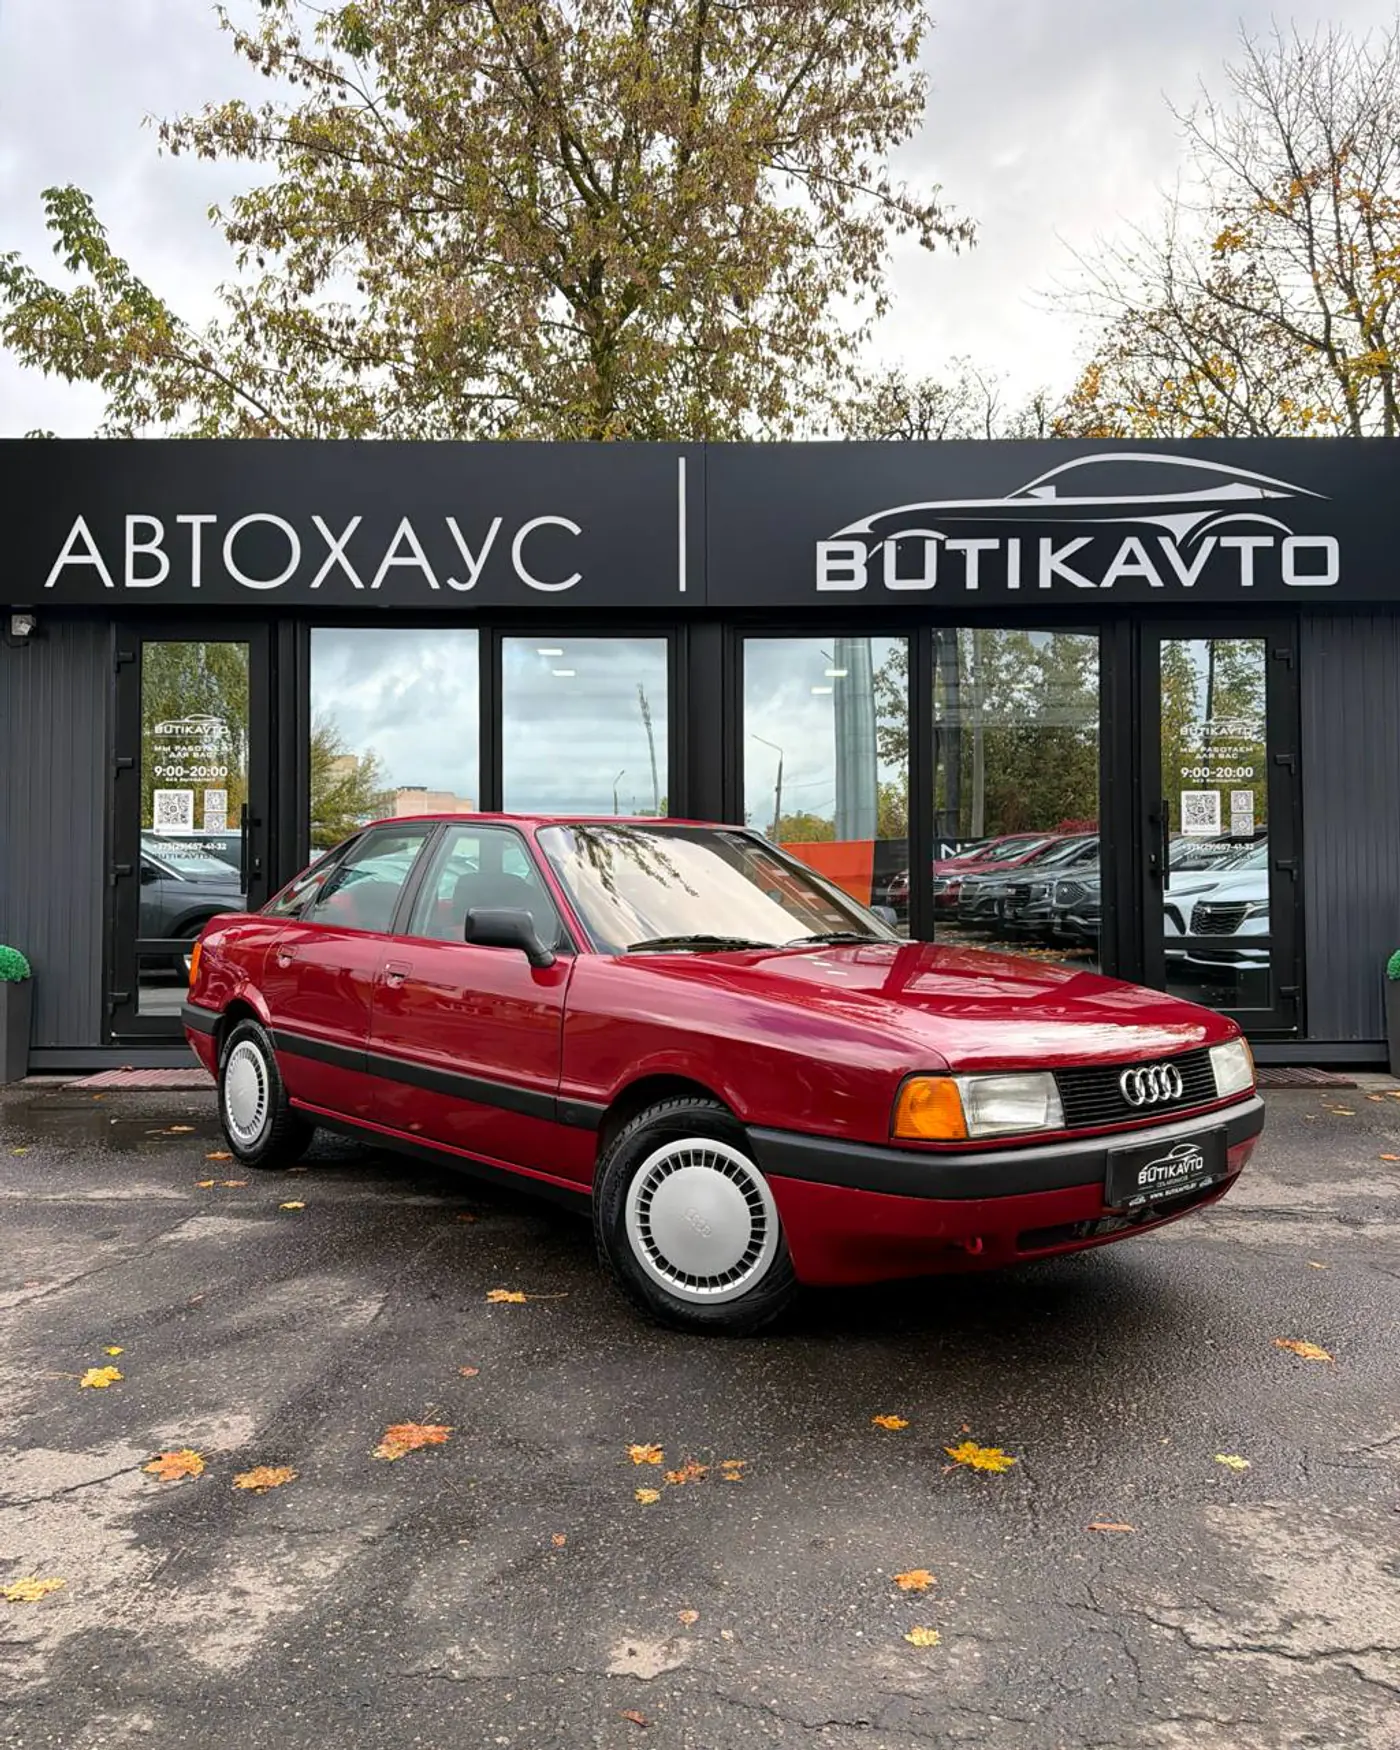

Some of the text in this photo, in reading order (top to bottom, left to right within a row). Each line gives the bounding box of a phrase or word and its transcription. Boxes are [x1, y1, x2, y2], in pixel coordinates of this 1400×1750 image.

[44, 513, 583, 592] АВТОХАУС
[816, 534, 1340, 592] BUTIKAVTO
[154, 765, 228, 777] 9:00-20:00
[1181, 766, 1254, 778] 9:00-20:00
[1138, 1156, 1203, 1185] BUTIKAVTO
